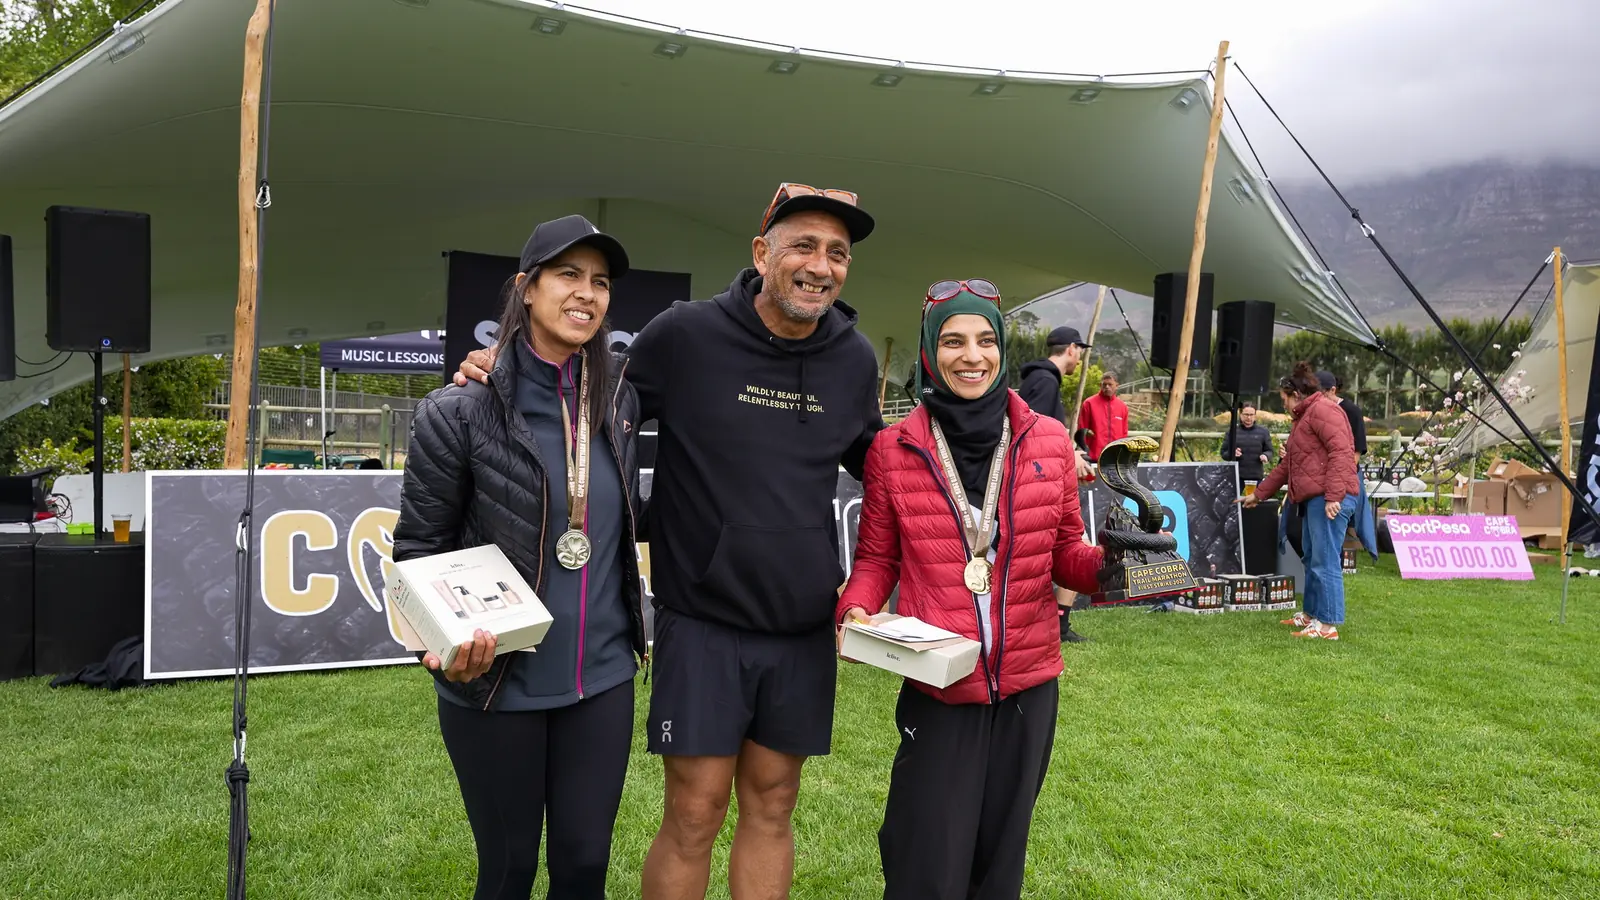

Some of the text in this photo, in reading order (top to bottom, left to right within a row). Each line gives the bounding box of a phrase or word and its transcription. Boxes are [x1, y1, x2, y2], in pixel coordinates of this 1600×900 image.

[341, 349, 384, 362] MUSIC
[746, 385, 819, 402] WILDLY BEAUTUL.
[738, 394, 825, 413] RELENTLESSLY TUGH.
[1389, 519, 1471, 537] SportPesa
[1485, 516, 1510, 526] CAPE
[1407, 546, 1517, 568] R50 000.00
[1131, 563, 1185, 579] CAPE COBRA
[1133, 571, 1187, 585] TRAIL MARATHON
